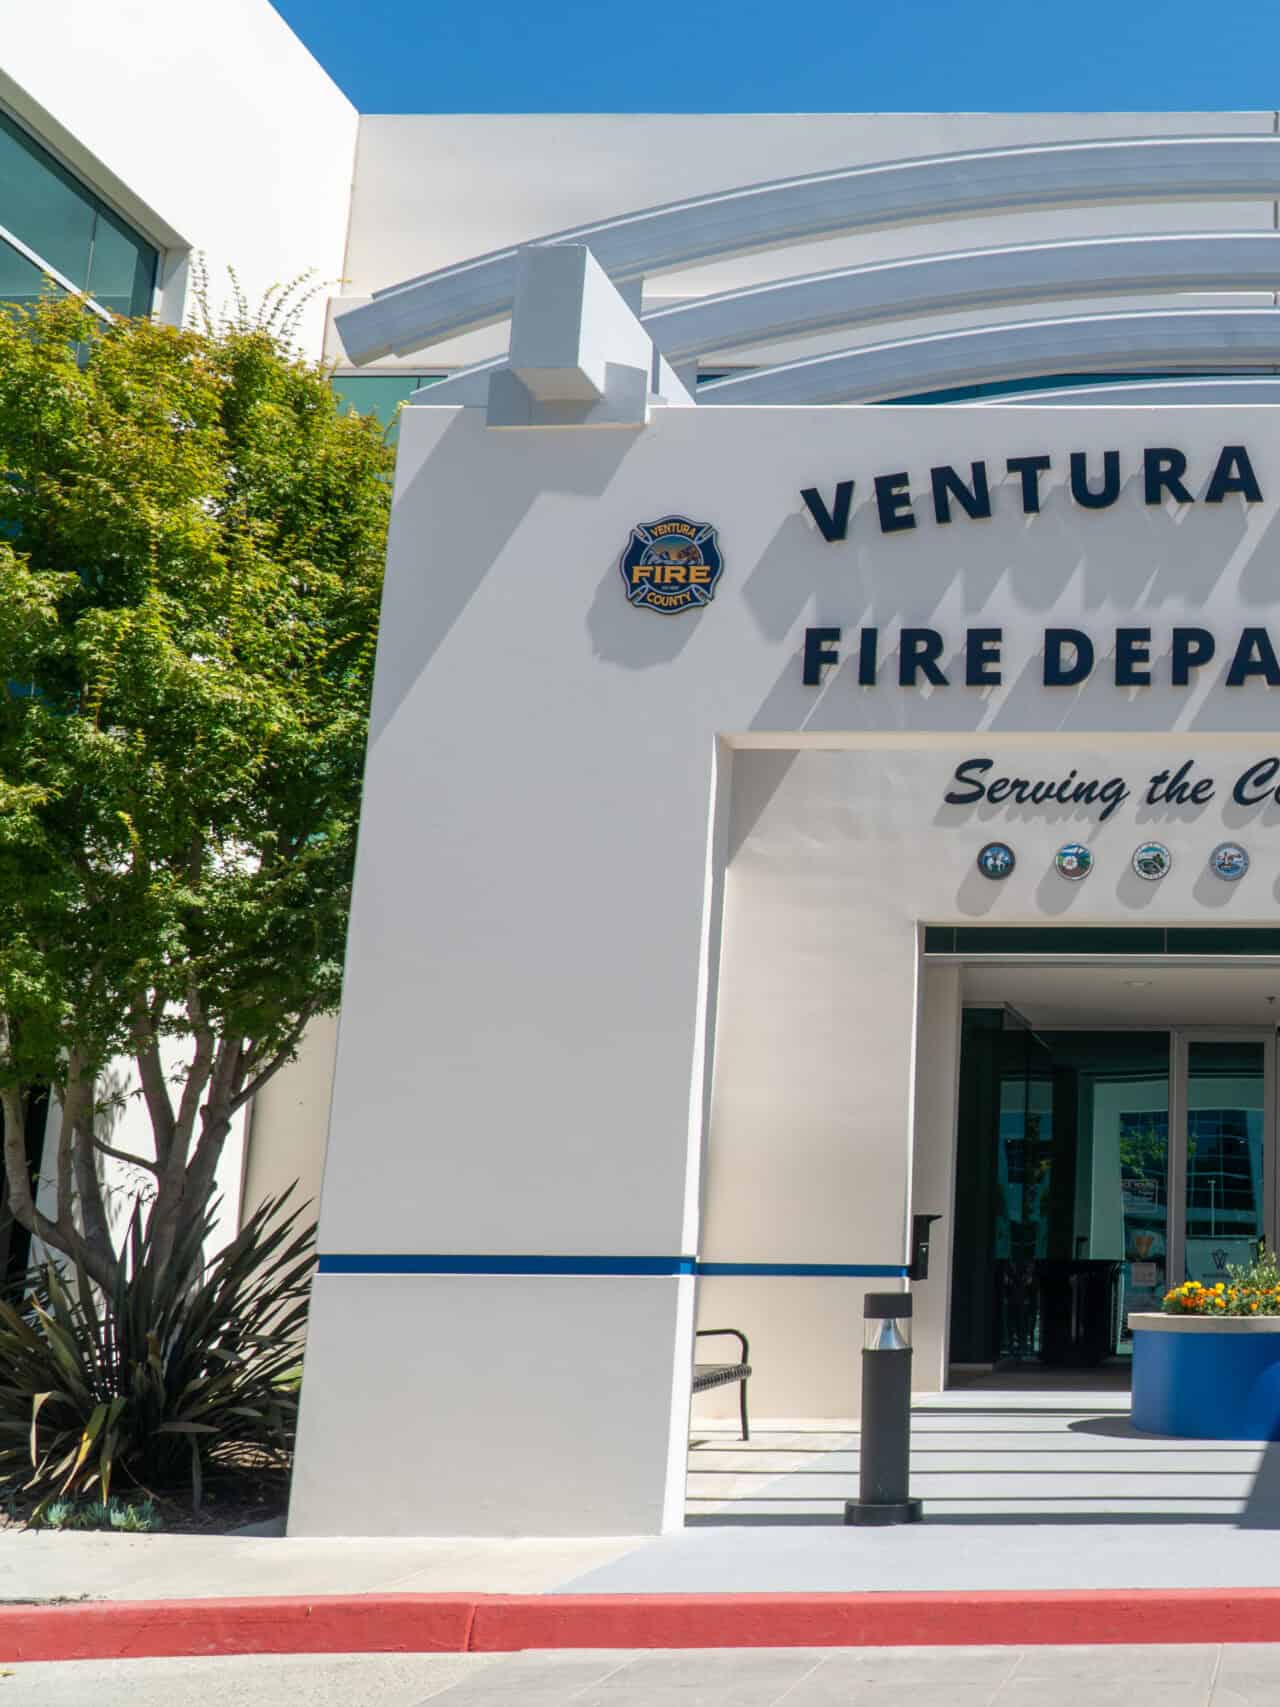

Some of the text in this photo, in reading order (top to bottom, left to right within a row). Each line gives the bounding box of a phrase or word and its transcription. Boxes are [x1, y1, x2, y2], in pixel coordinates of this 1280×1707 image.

[799, 445, 1265, 544] VENTURA
[650, 522, 697, 538] VENTURA
[631, 565, 712, 584] FIRE
[646, 591, 692, 607] COUNTY
[801, 627, 1004, 688] FIRE
[943, 757, 1131, 823] Serving
[1144, 758, 1216, 806] the
